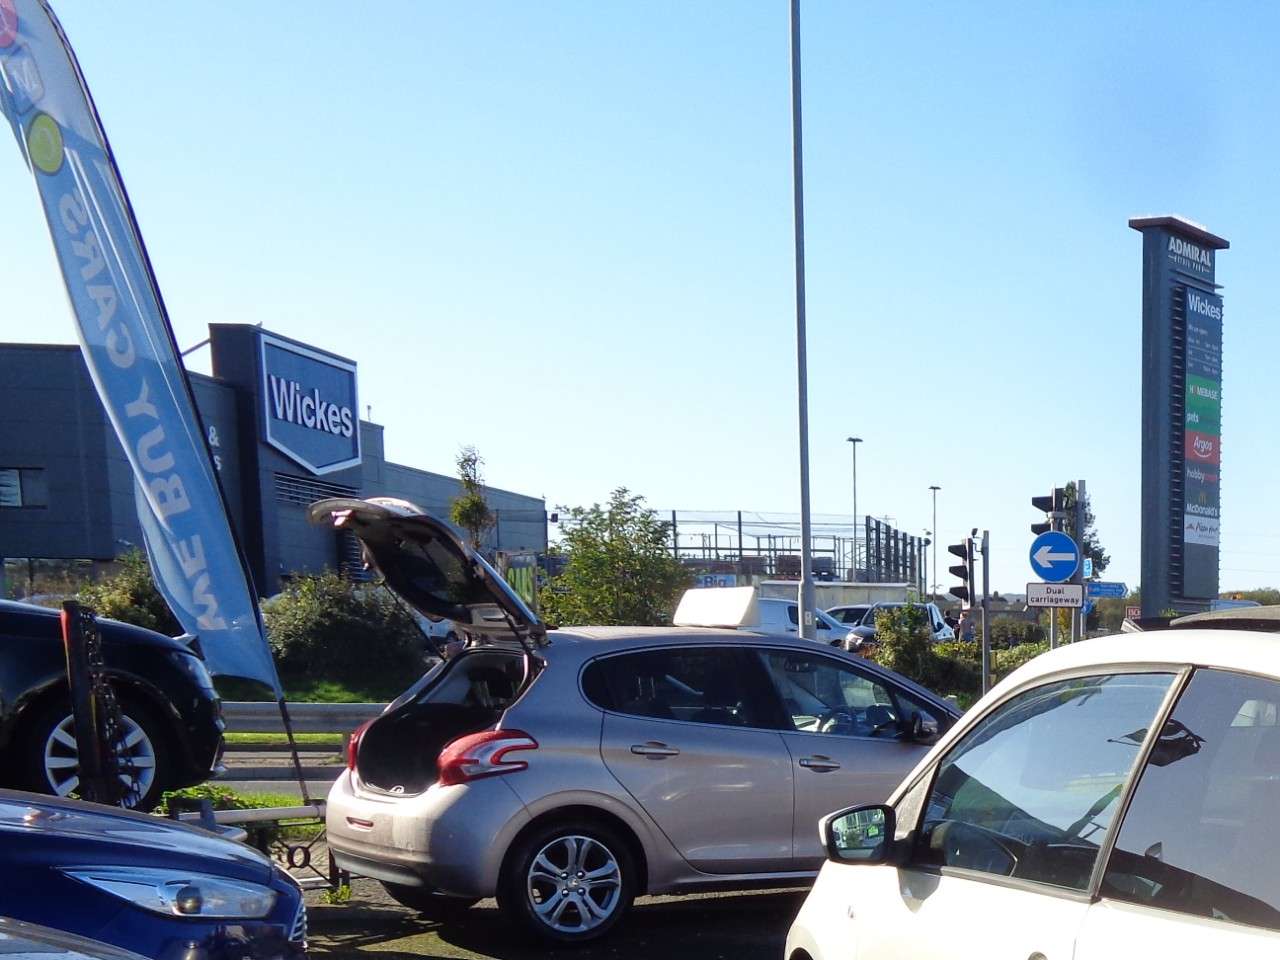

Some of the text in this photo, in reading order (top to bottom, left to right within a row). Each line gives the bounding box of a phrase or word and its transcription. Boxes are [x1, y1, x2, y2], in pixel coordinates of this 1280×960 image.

[1168, 236, 1211, 266] ADMIRAL
[1188, 293, 1221, 320] Wickes
[270, 374, 353, 438] Wickes
[208, 425, 220, 447] &
[1193, 436, 1213, 452] Argos
[1030, 594, 1080, 605] carriageway
[1046, 586, 1065, 595] Dual
